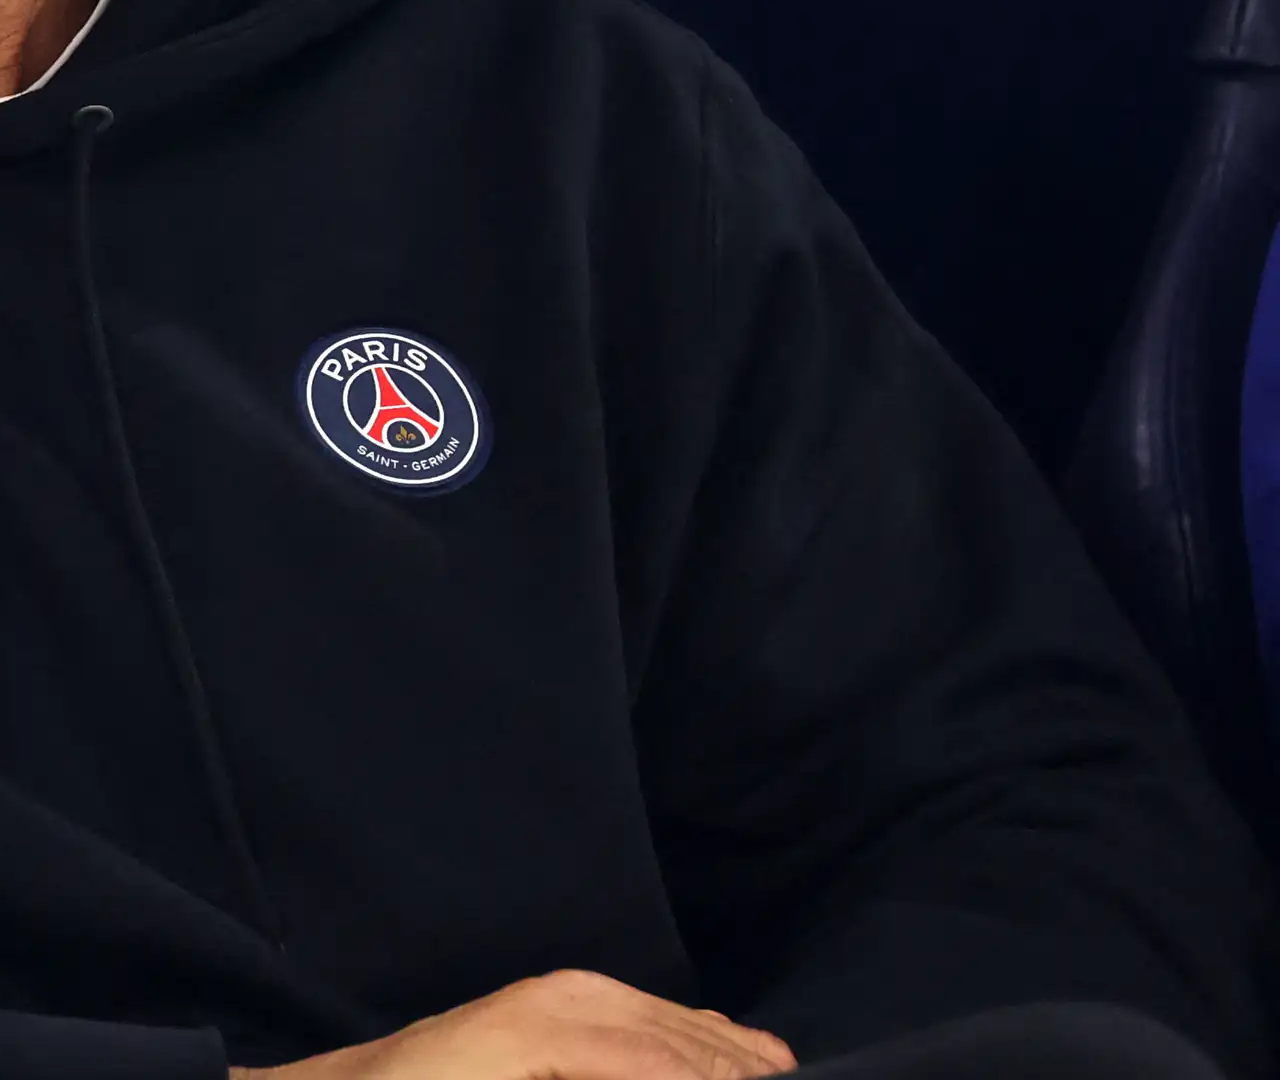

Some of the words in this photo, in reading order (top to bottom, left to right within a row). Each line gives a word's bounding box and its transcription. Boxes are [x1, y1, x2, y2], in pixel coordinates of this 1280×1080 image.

[321, 340, 428, 381] PARIS
[356, 444, 400, 469] SAINT
[412, 436, 461, 471] GERMAIN
